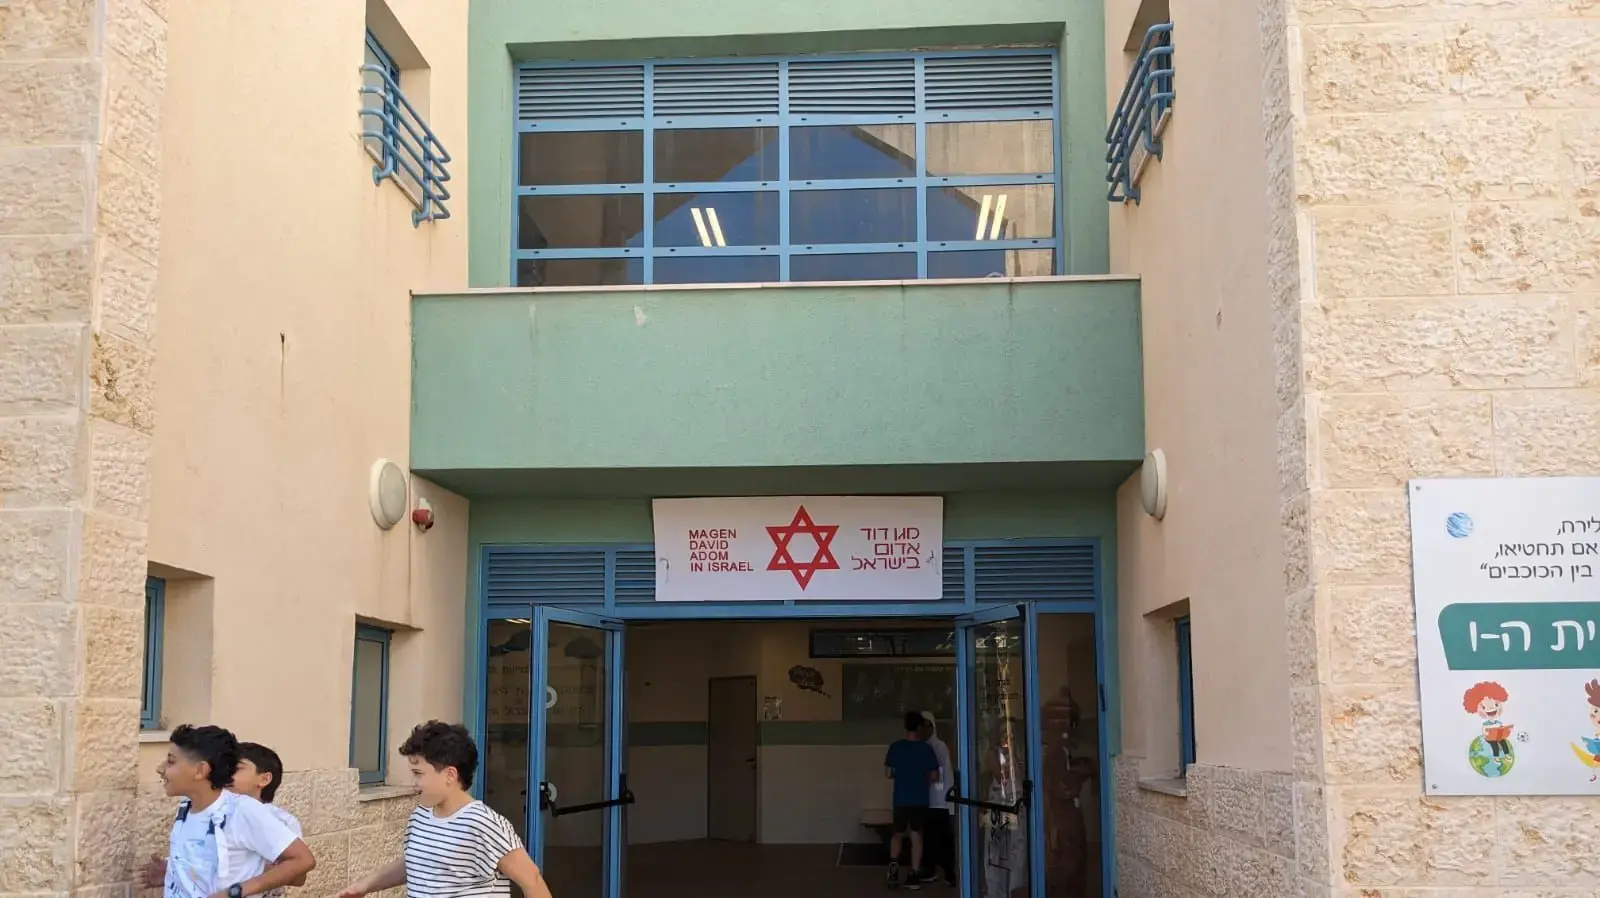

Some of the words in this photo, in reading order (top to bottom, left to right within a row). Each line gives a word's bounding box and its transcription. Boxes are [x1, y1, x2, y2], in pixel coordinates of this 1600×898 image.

[1556, 515, 1600, 536] לירח,
[688, 528, 737, 540] MAGEN
[860, 527, 889, 541] דוד
[894, 527, 920, 541] מגן
[689, 540, 729, 551] DAVID
[874, 542, 921, 556] אדום
[1494, 542, 1564, 559] תחטיאו,
[1572, 542, 1598, 556] אם
[689, 551, 729, 561] ADOM
[851, 555, 921, 571] בישראל
[690, 562, 705, 572] IN
[707, 561, 754, 572] ISRAEL
[1570, 564, 1593, 583] בין
